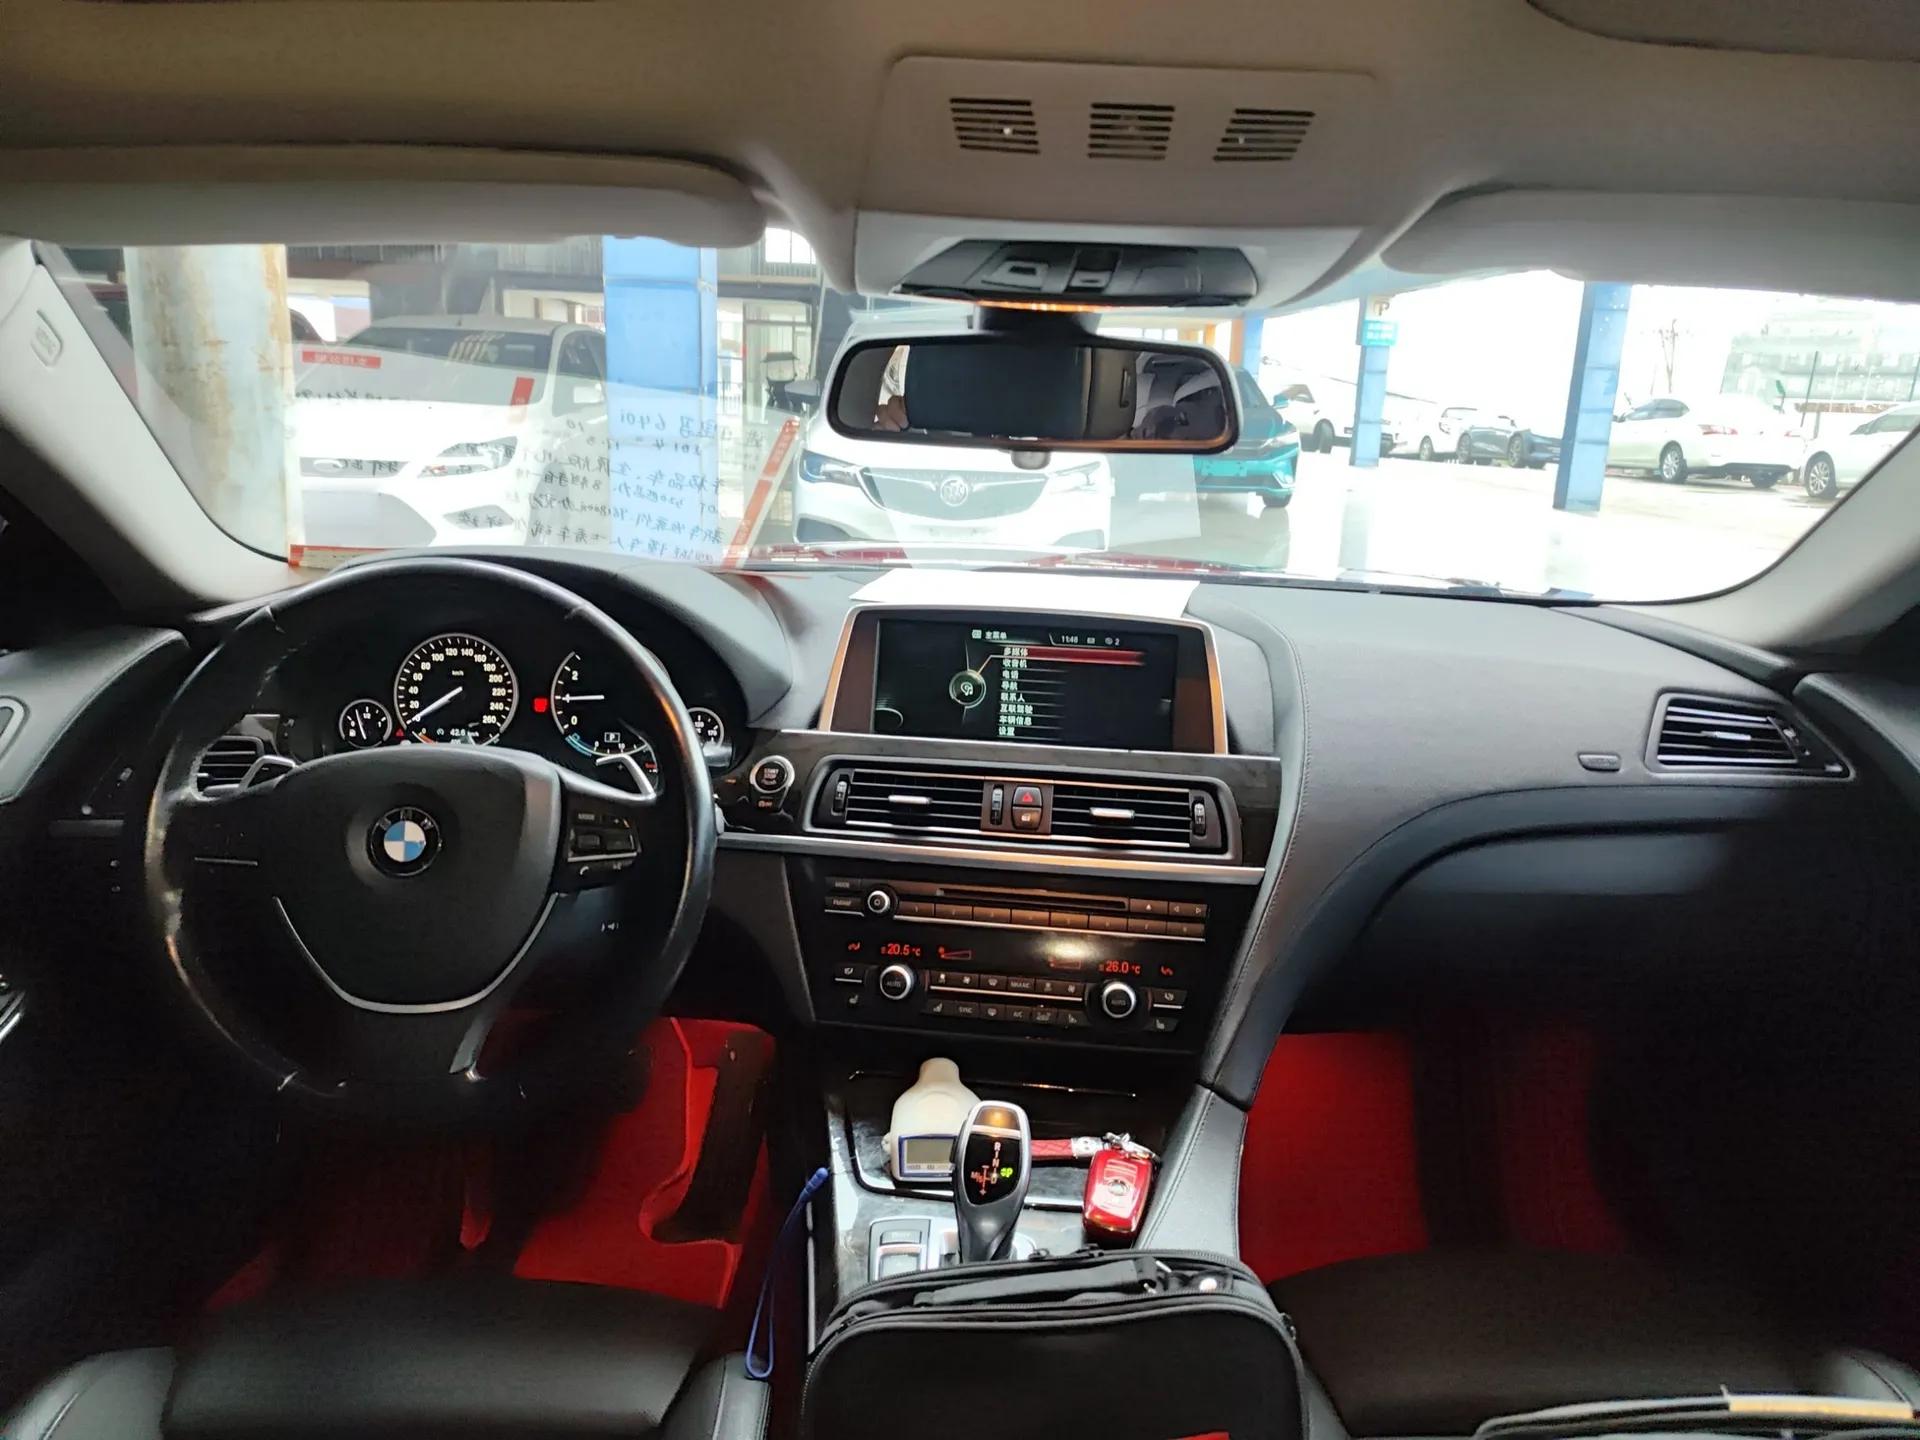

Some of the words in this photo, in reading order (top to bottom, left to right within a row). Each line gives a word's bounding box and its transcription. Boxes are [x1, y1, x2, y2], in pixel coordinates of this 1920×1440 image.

[445, 648, 458, 657] 120
[461, 648, 474, 657] 140
[1003, 647, 1028, 657] 多媒体
[431, 653, 444, 662] 100
[474, 654, 487, 663] 160
[421, 662, 431, 671] 80
[483, 663, 496, 672] 180
[1002, 658, 1027, 669] 收音机
[413, 672, 423, 681] 60
[489, 674, 503, 683] 200
[571, 670, 579, 681] 2
[1002, 670, 1019, 680] 电话
[1001, 680, 1018, 691] 导航
[408, 686, 418, 695] 40
[492, 688, 506, 697] 220
[1000, 692, 1026, 703] 联系人
[409, 701, 420, 709] 20
[490, 702, 504, 711] 240
[482, 715, 497, 724] 260
[571, 715, 578, 726] 0
[999, 715, 1032, 726] 车辆信息
[998, 726, 1015, 737] 设置
[887, 943, 910, 956] 20.5
[1105, 960, 1129, 974] 26.0
[994, 1141, 1001, 1151] R
[992, 1158, 1000, 1168] N
